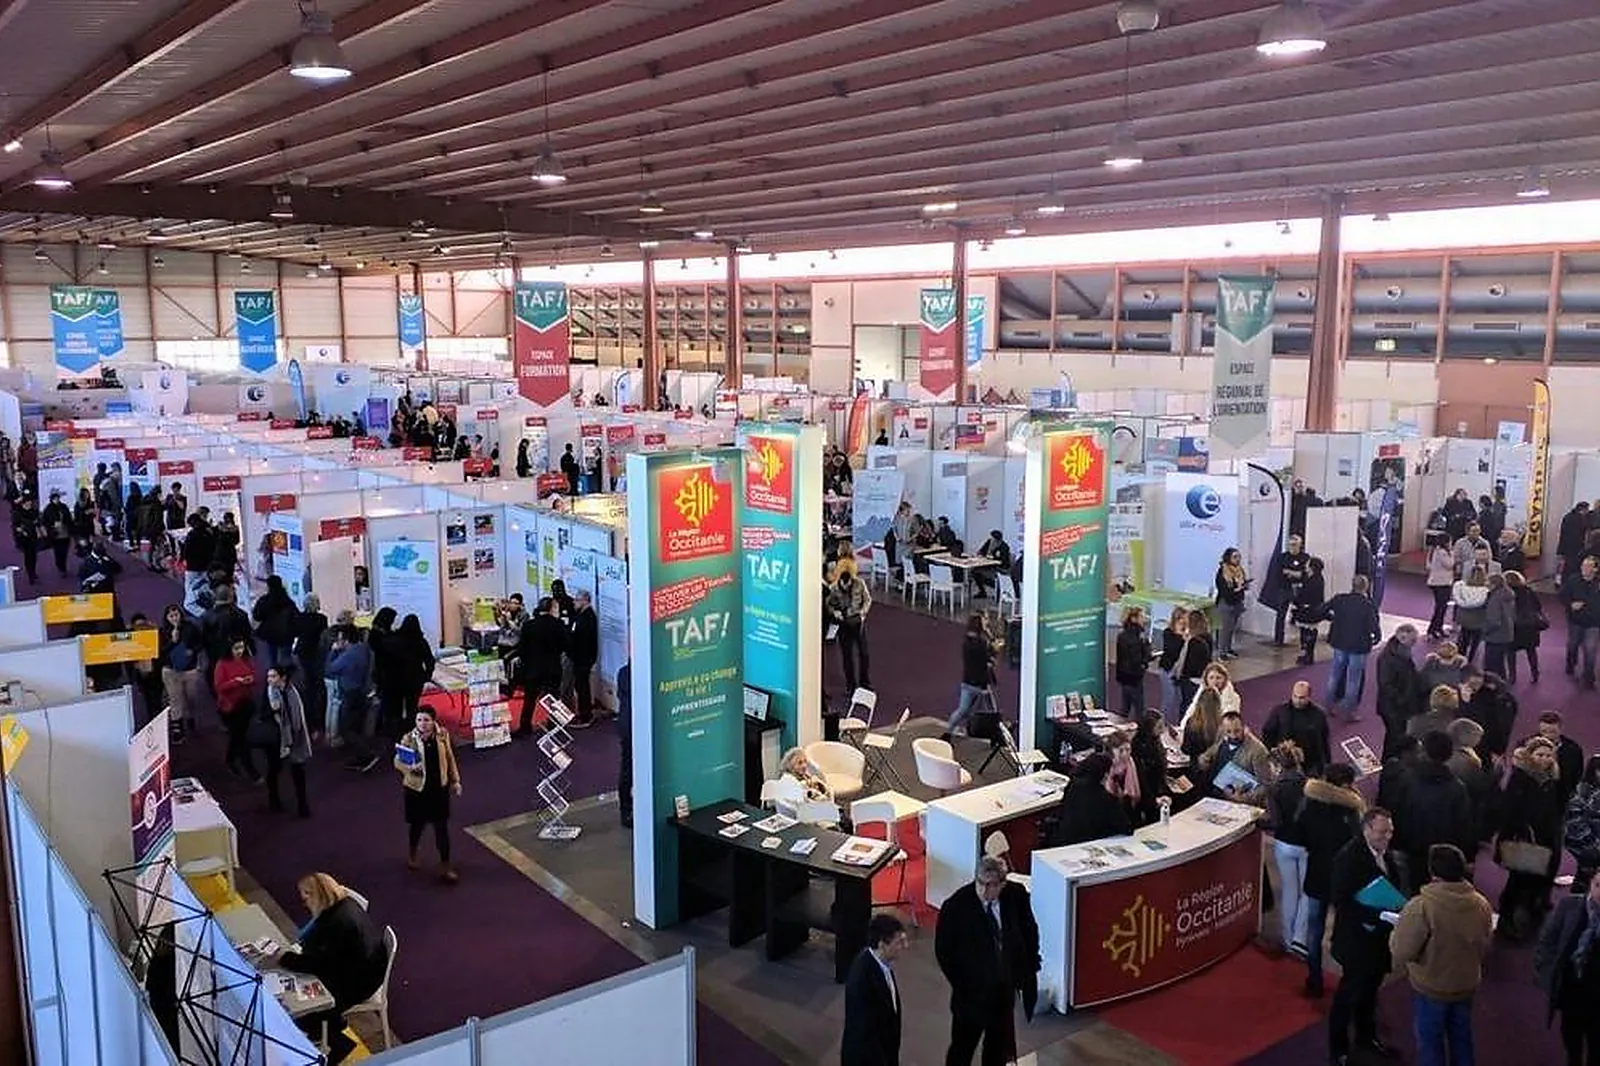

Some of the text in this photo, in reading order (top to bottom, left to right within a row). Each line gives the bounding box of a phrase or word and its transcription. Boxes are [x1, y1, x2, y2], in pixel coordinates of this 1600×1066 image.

[53, 292, 92, 306] TAF!
[237, 296, 271, 310] TAF!
[518, 290, 565, 308] TAF!
[922, 295, 955, 313] TAF!
[1222, 289, 1272, 315] TAF!
[520, 363, 567, 377] FORMATION
[1230, 362, 1255, 375] ESPACE
[669, 532, 726, 551] Occitanie
[747, 554, 790, 583] TAF!
[1049, 554, 1098, 580] TAF!
[665, 612, 730, 648] TAF!
[1177, 898, 1189, 911] La
[1177, 883, 1252, 933] Occitanie
